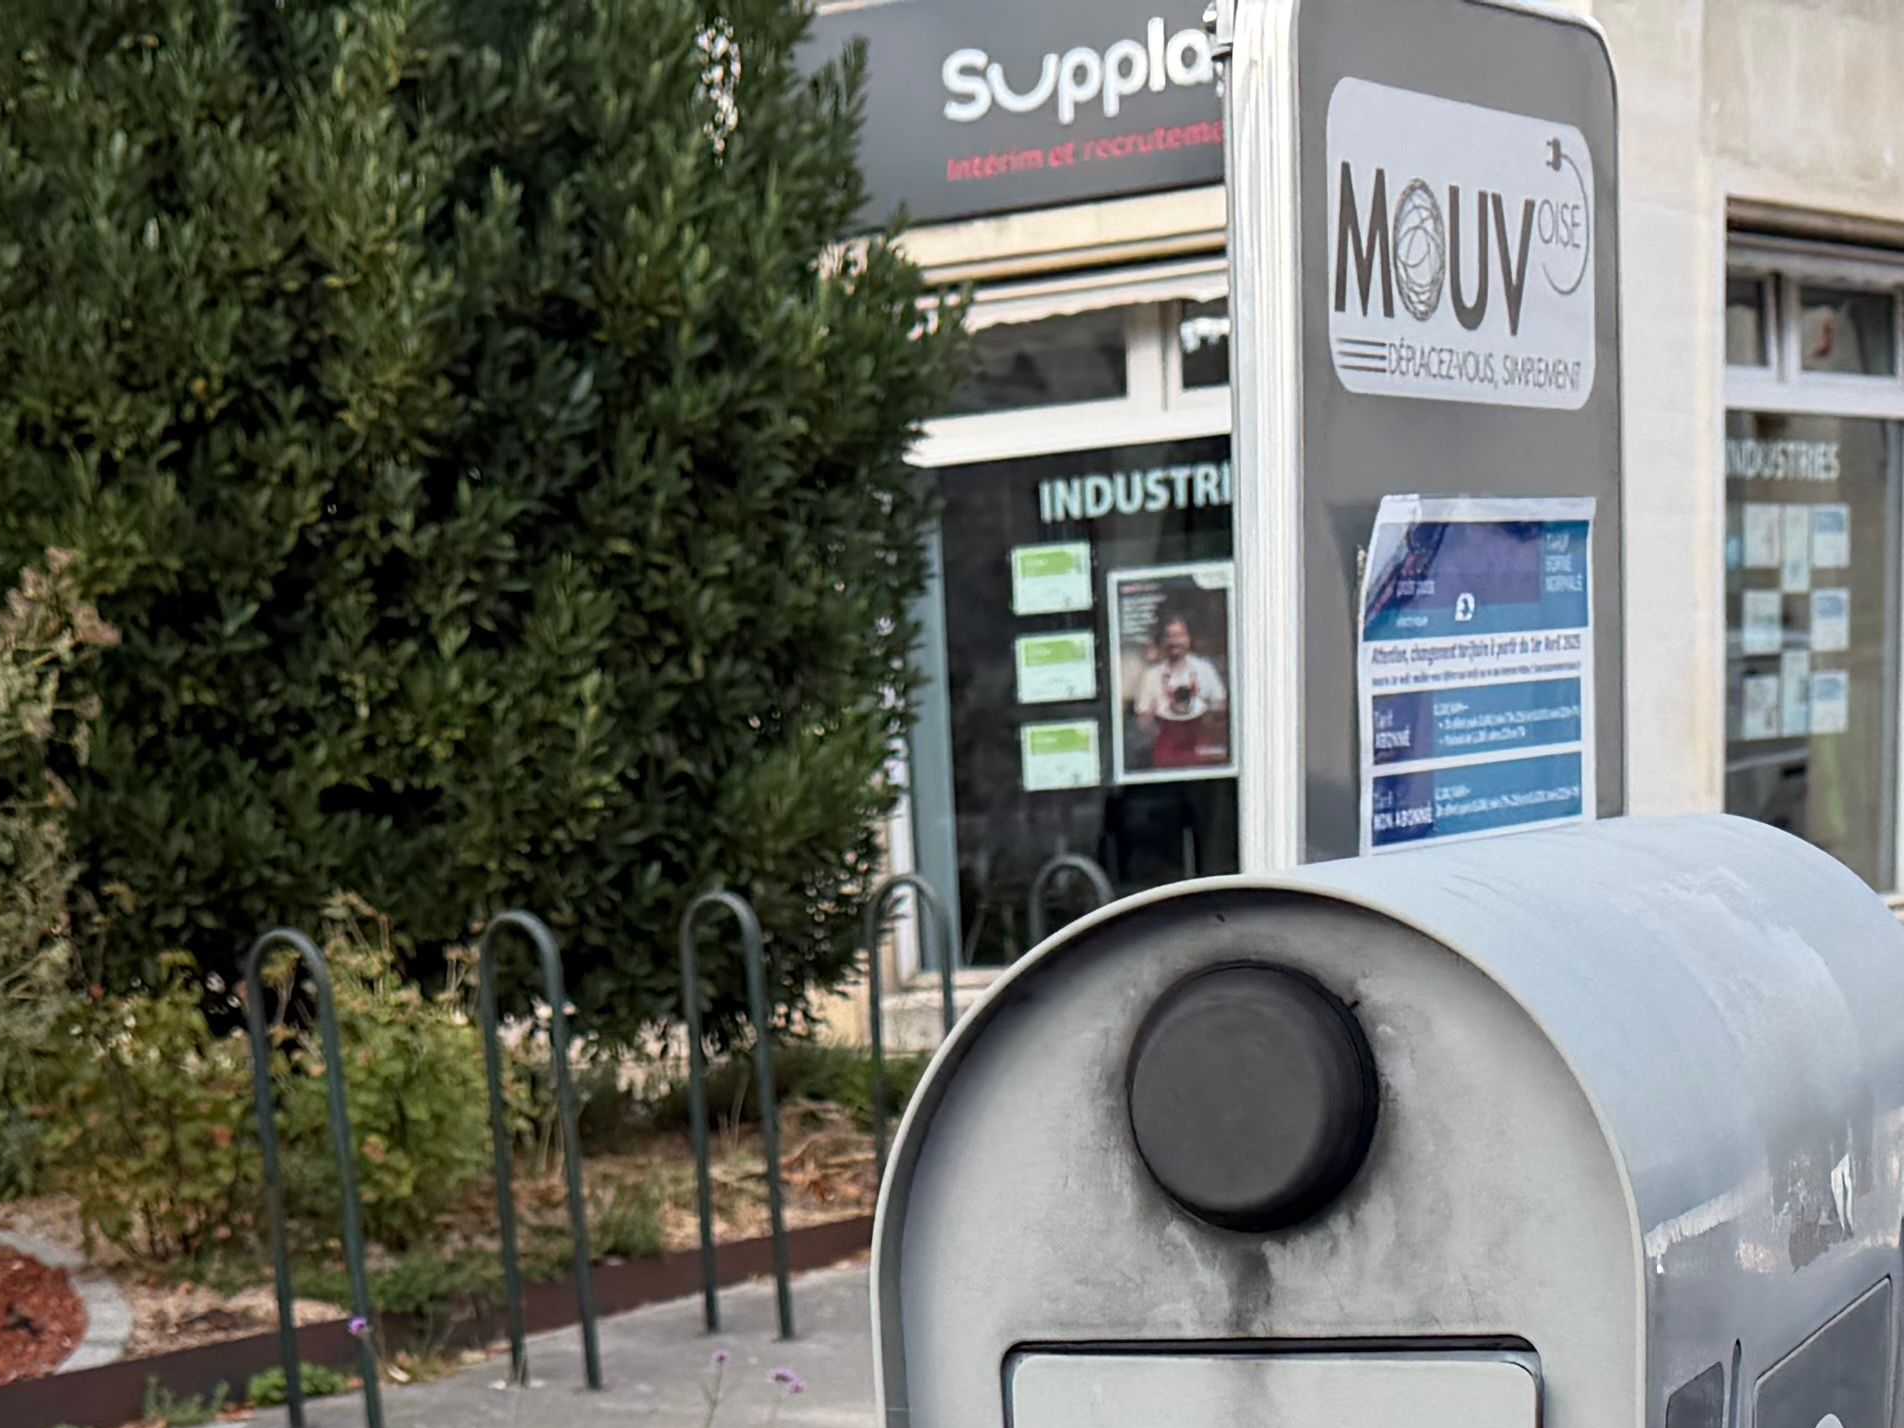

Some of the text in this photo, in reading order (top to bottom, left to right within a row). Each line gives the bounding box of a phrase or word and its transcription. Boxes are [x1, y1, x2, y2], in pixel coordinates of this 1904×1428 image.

[1049, 142, 1076, 168] et
[1334, 161, 1536, 336] MOUV
[1502, 354, 1582, 391] SIMPLEMENT
